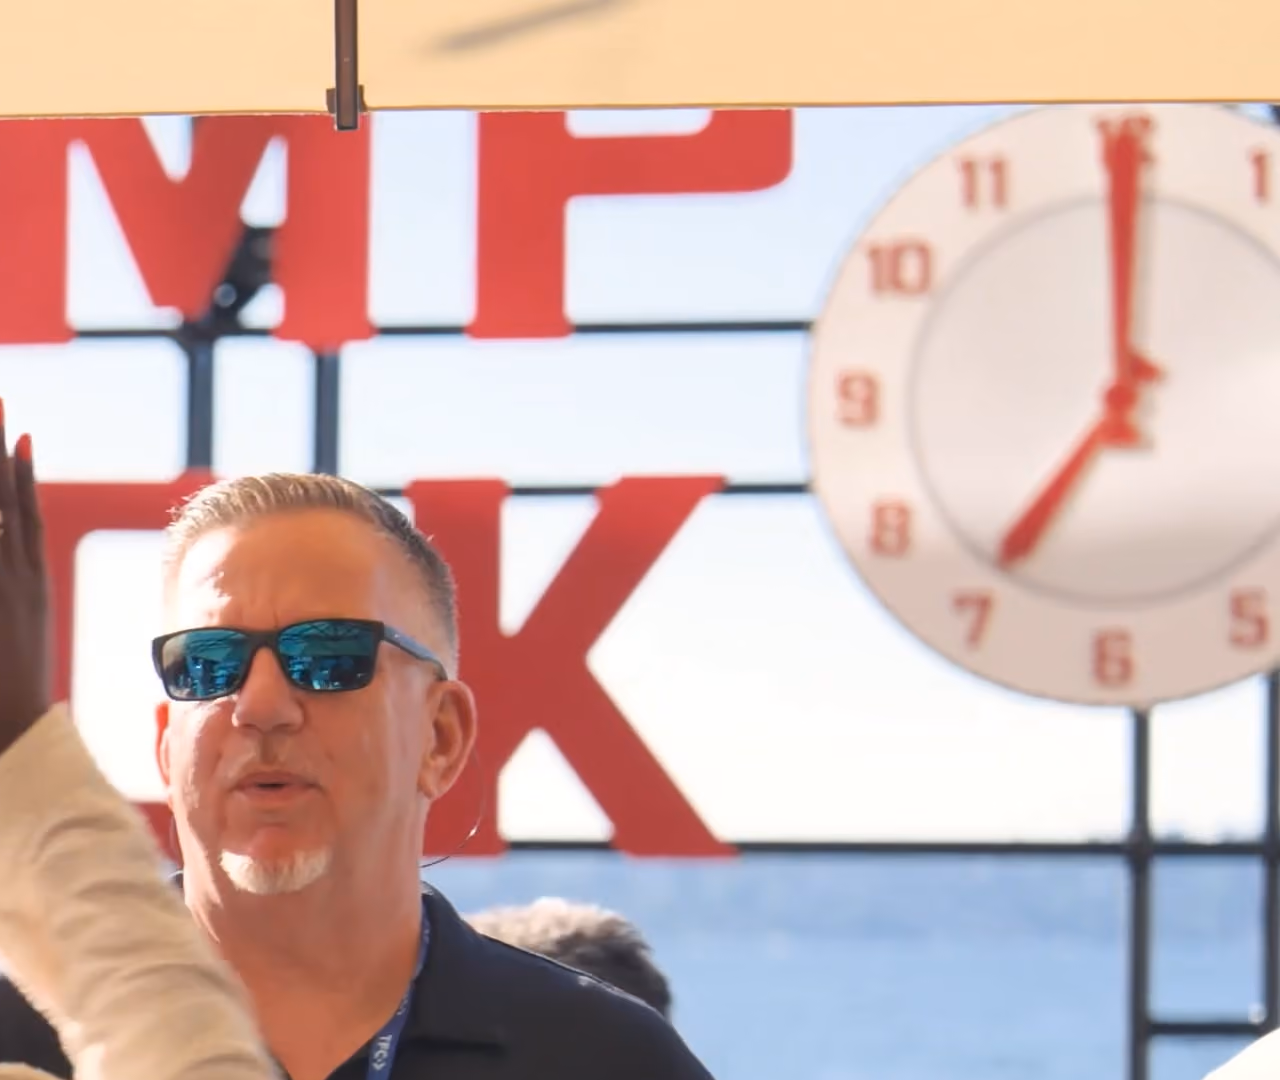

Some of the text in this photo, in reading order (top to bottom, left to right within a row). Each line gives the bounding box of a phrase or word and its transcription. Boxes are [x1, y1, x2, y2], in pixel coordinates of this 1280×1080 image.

[961, 159, 1009, 206] 11
[1249, 150, 1271, 204] 1
[867, 239, 931, 297] 10
[837, 371, 881, 428] 9
[869, 501, 913, 559] 8
[951, 589, 995, 651] 7
[1229, 586, 1269, 650] 5
[1091, 629, 1134, 689] 6
